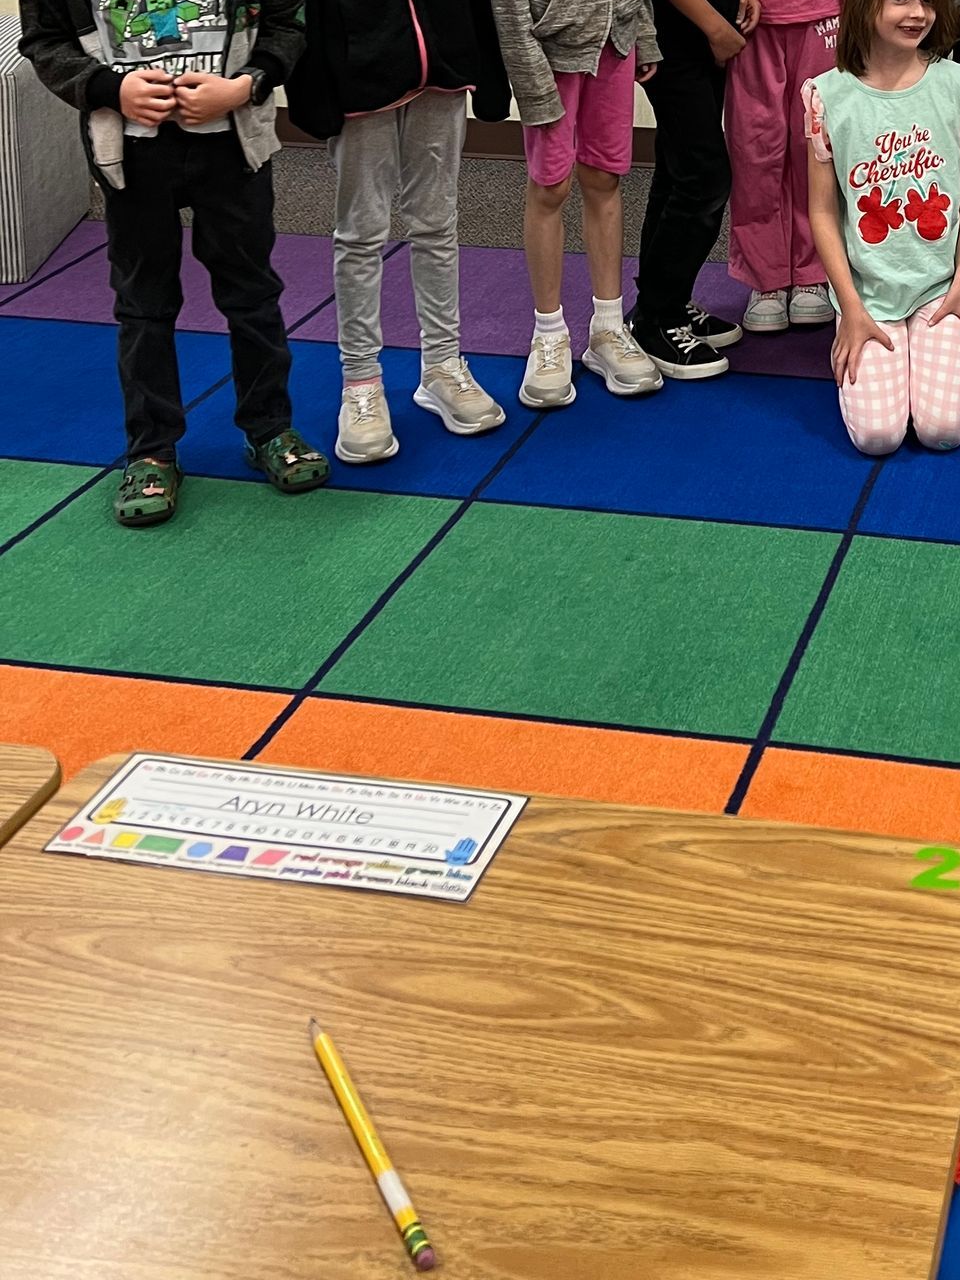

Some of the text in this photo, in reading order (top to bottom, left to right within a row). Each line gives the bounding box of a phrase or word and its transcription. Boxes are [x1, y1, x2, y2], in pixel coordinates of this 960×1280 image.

[875, 124, 931, 164] You're
[849, 146, 946, 190] Cherrific
[218, 795, 374, 825] Aryn White
